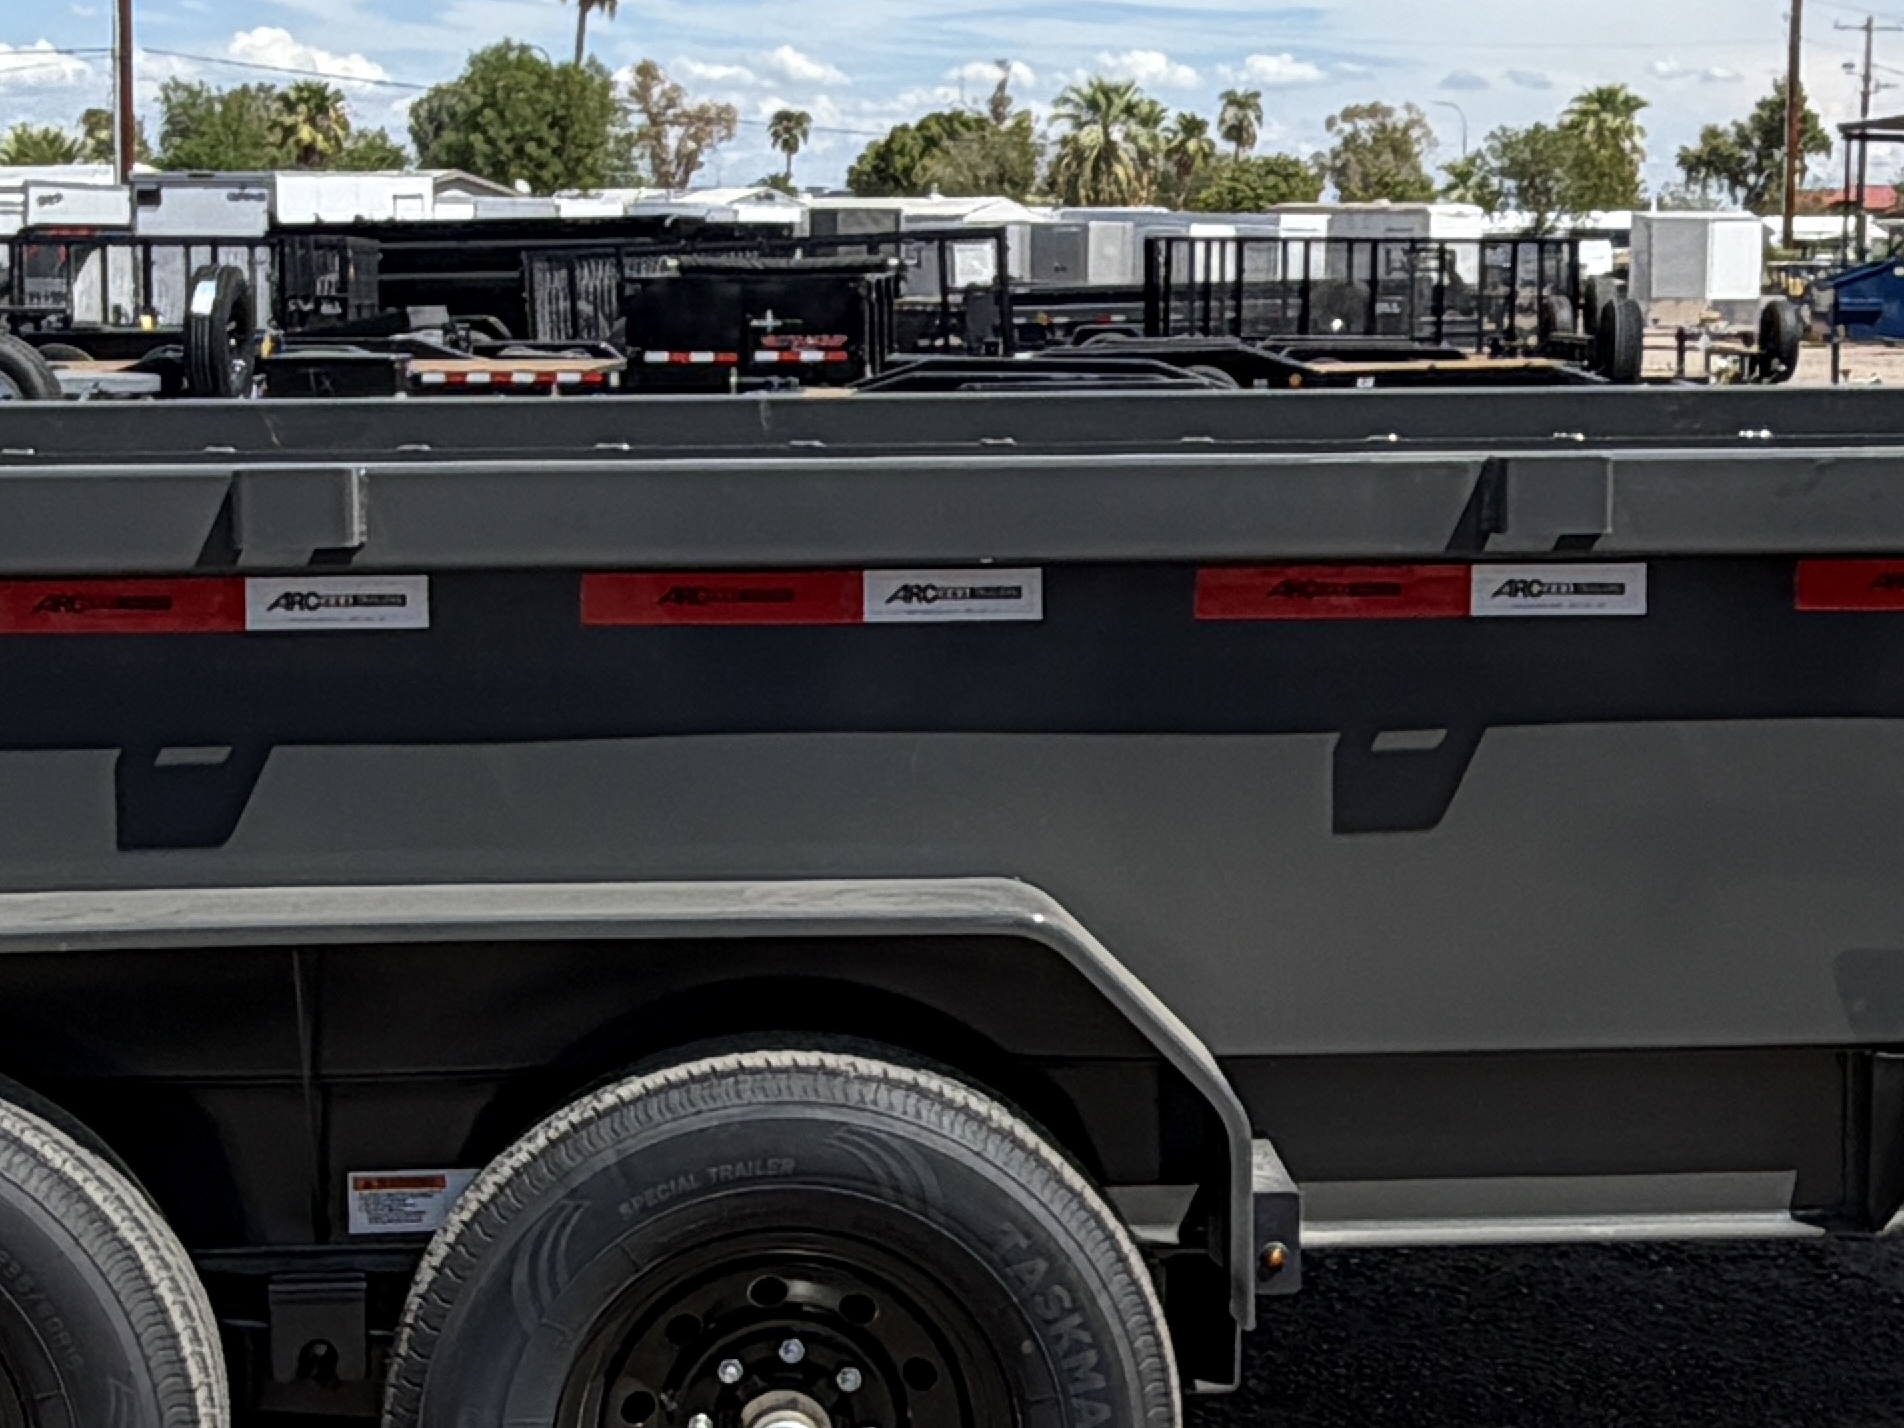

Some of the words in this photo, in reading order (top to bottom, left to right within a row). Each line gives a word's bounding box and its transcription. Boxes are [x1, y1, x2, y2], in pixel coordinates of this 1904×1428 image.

[885, 582, 939, 604] ARC
[1491, 578, 1544, 599] ARC
[267, 590, 320, 612] ARC
[617, 1180, 699, 1220] SPECIAL
[706, 1156, 798, 1192] TRAILER
